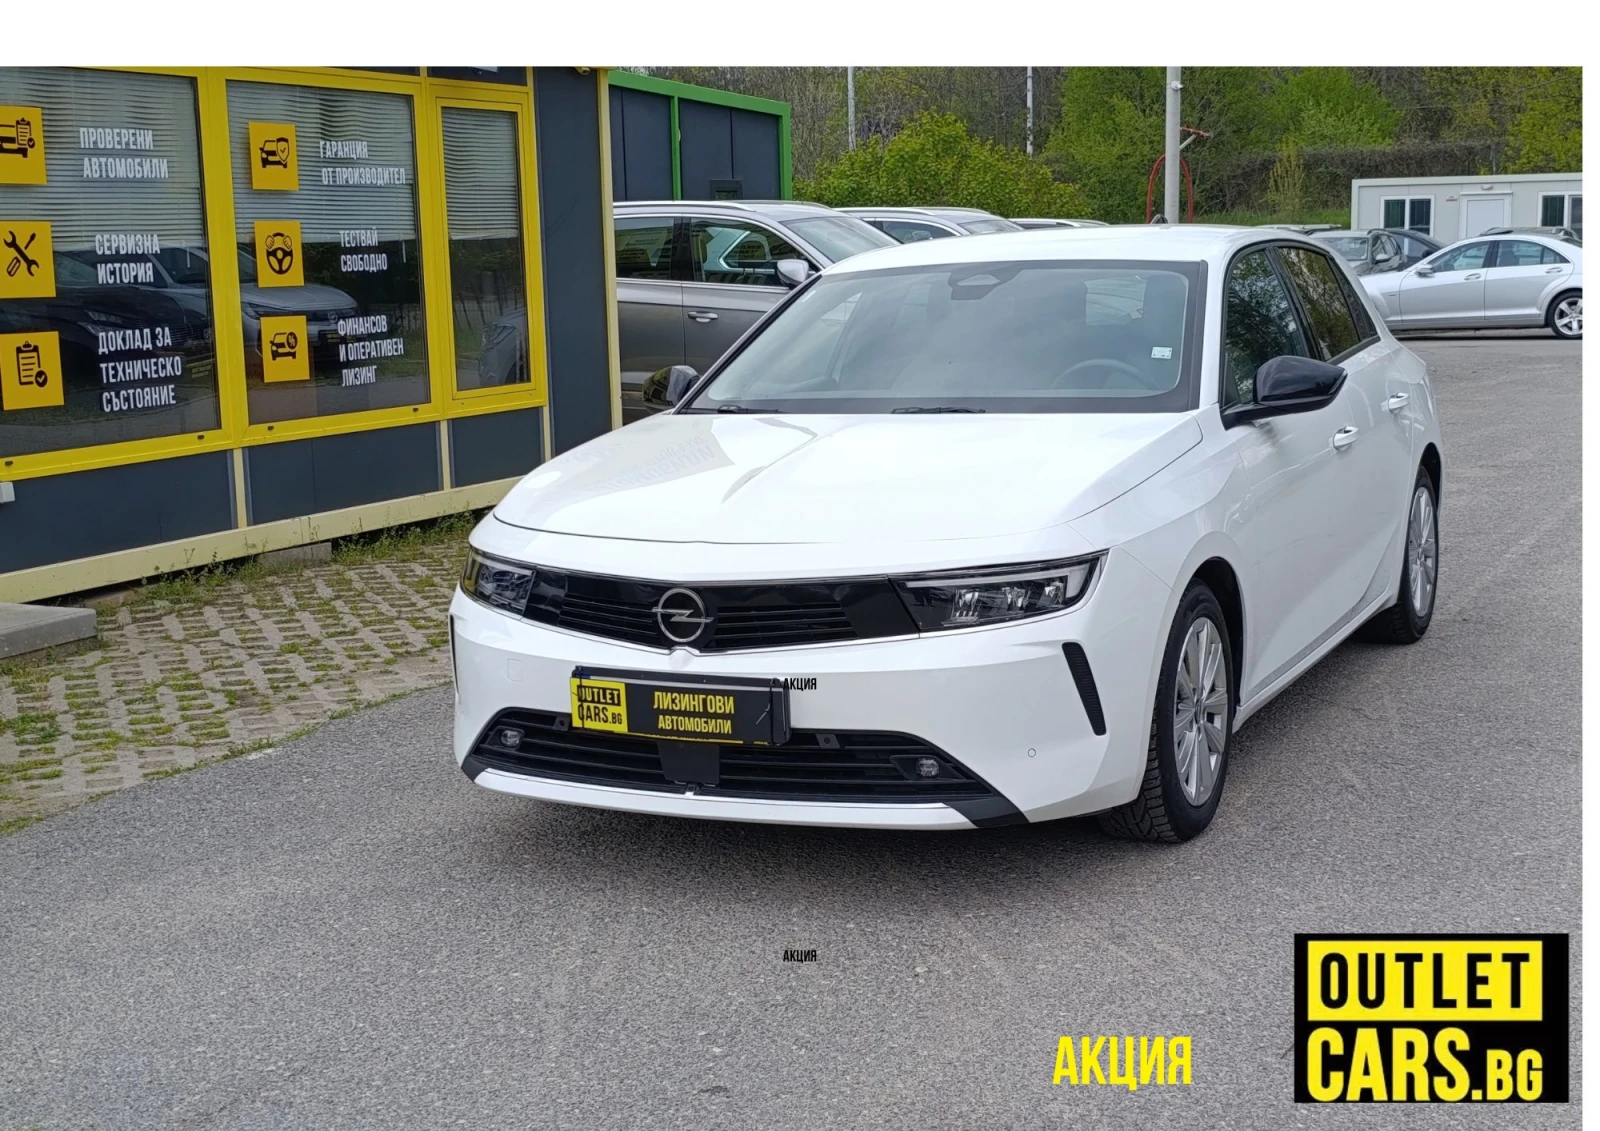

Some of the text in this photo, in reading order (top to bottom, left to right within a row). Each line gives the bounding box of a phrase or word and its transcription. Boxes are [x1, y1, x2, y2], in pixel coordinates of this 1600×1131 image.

[79, 127, 154, 150] ПРОВЕРЕНИ
[320, 141, 368, 159] ГАРАНЦИЯ
[83, 157, 169, 179] АВТОМОБИЛИ
[322, 167, 406, 186] ОТ ПРОИЗВОДИТЕЛ
[95, 233, 161, 255] СЕРВИЗНА
[339, 226, 379, 248] ТЕСТВАЙ
[97, 262, 154, 285] ИСТОРИЯ
[340, 253, 388, 272] СВОБОДНО
[337, 314, 388, 336] ФИНАНСОВ
[98, 326, 172, 355] ДОКЛАД ЗА
[339, 337, 404, 362] И ОПЕРАТИВЕН
[100, 355, 182, 384] ТЕХНИЧЕСКО
[342, 365, 378, 387] ЛИЗИНГ
[102, 385, 176, 412] СЪСТОЯНИЕ
[578, 687, 619, 704] OUTLET
[653, 691, 735, 714] ЛИЗИНГОВИ
[578, 704, 623, 725] CARS.BG
[658, 715, 732, 734] АВТОМОБИЛИ
